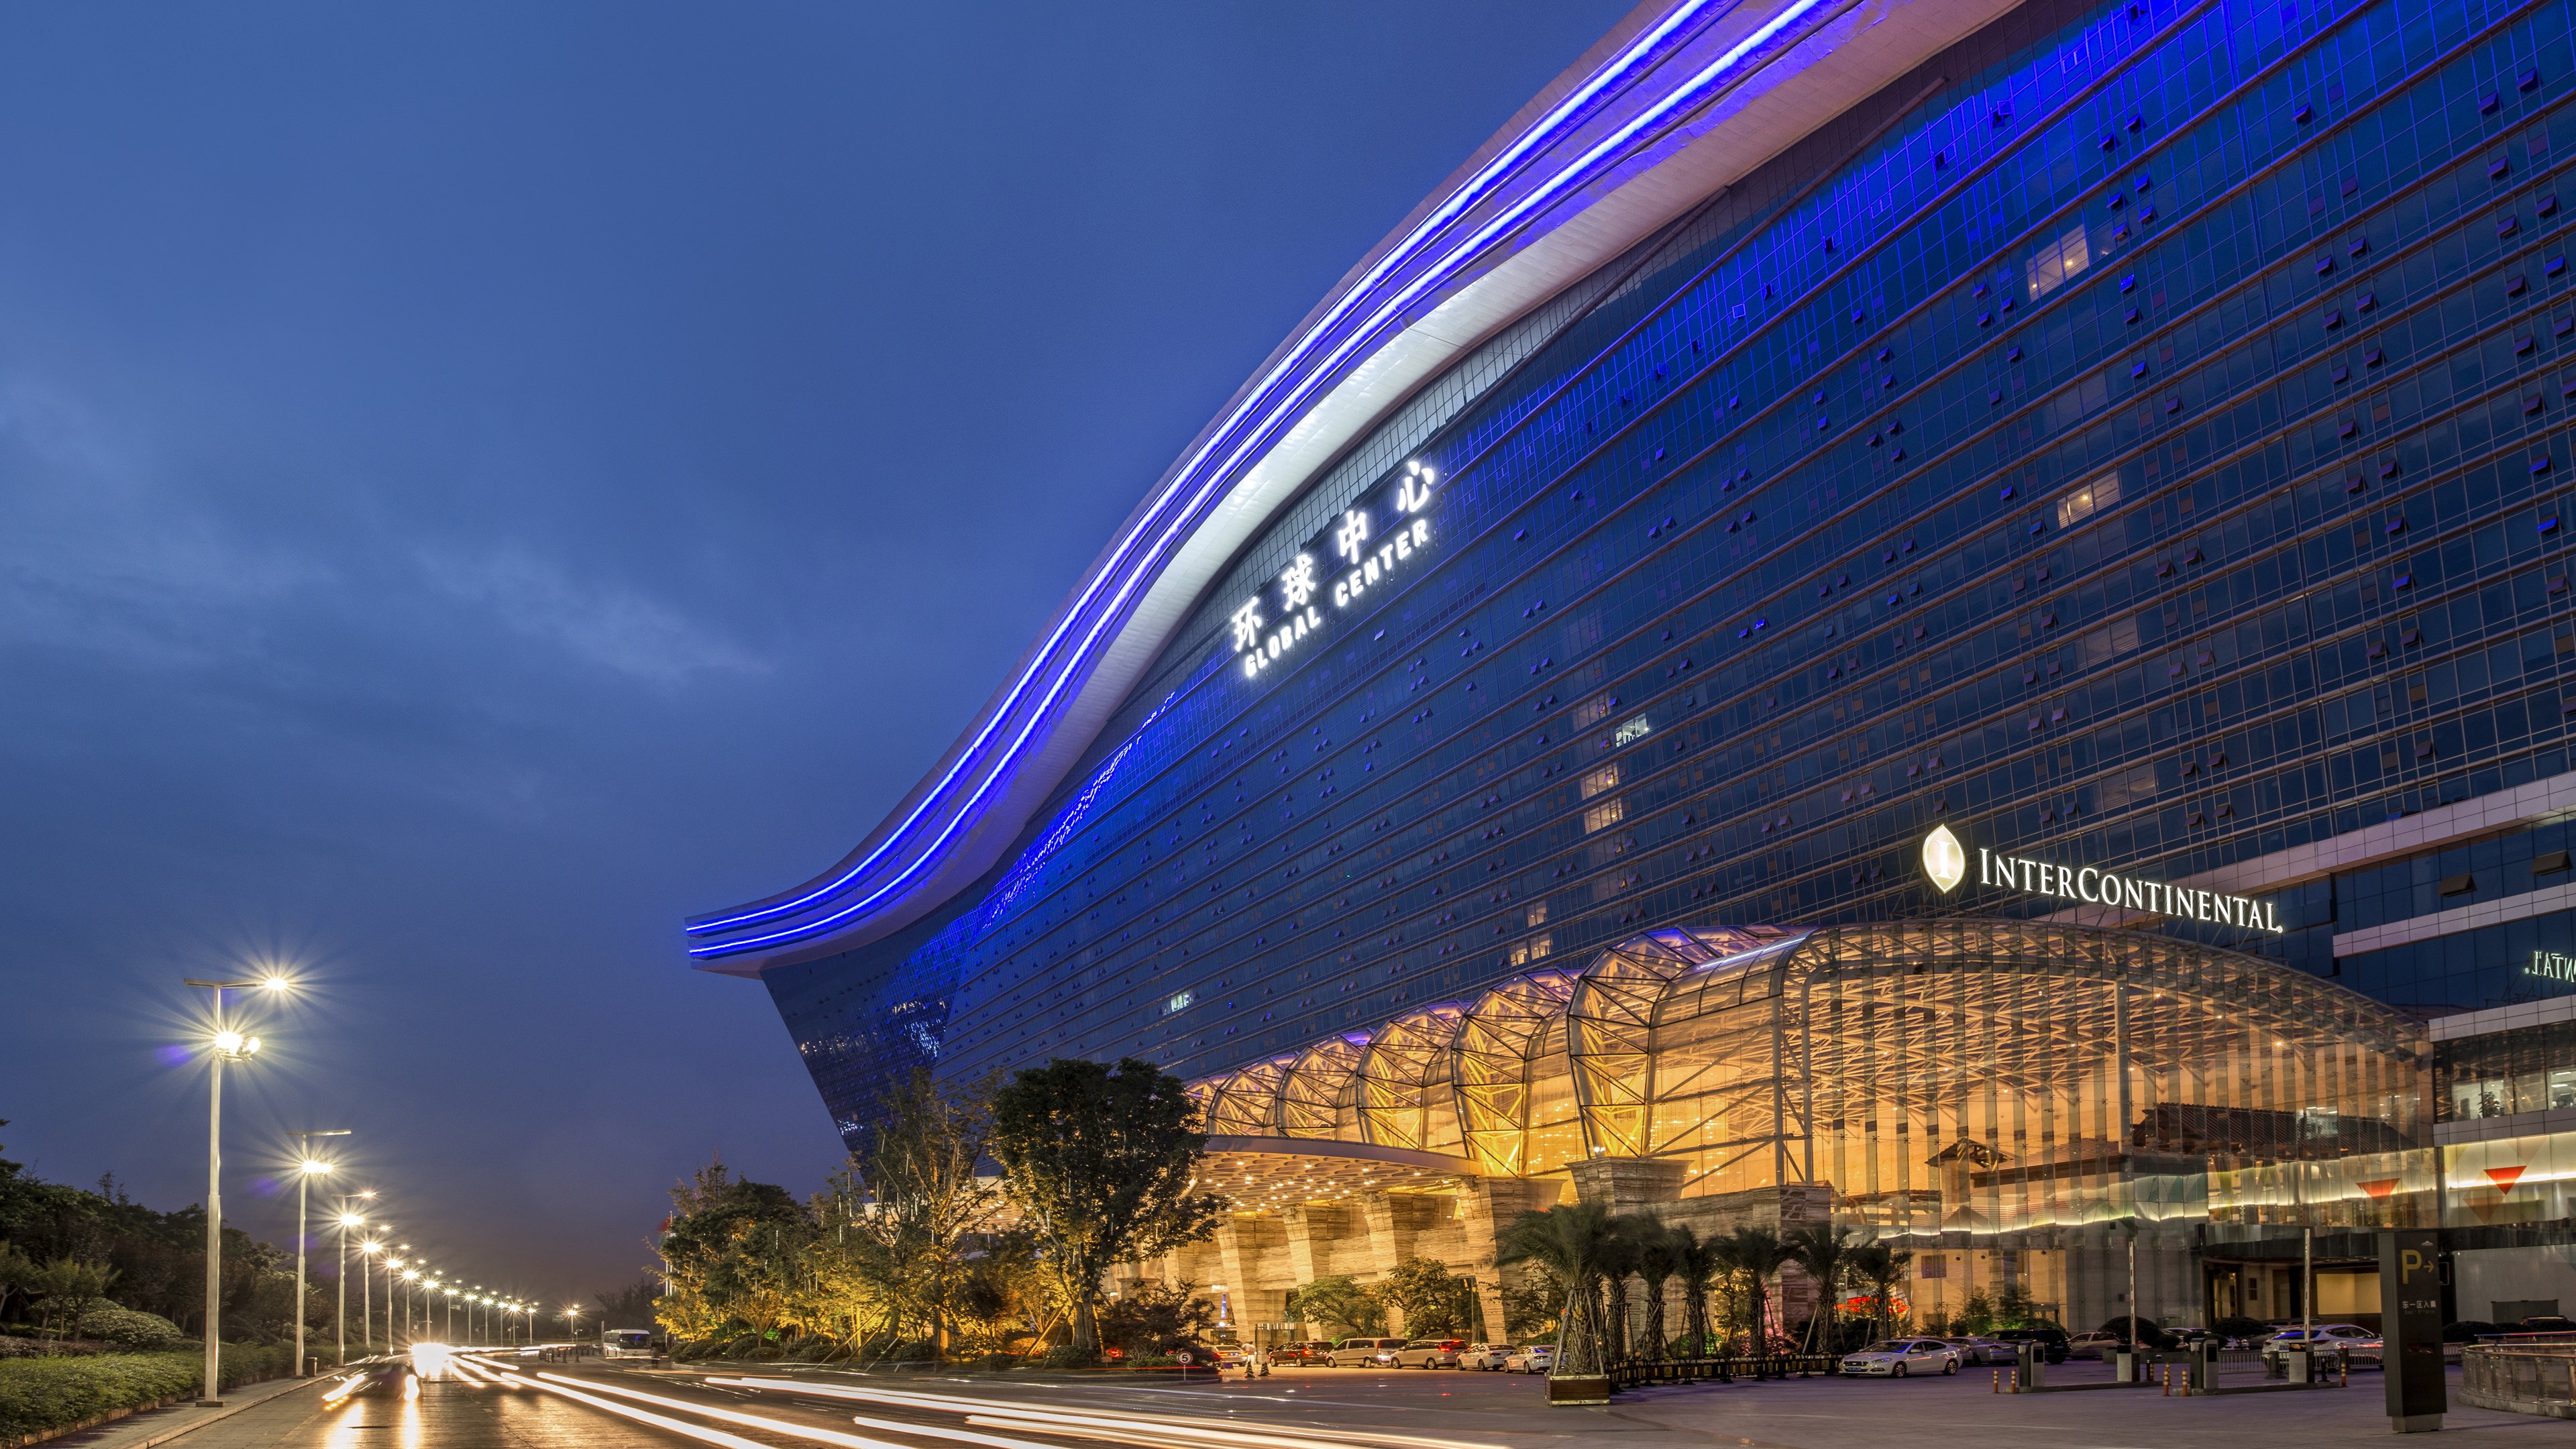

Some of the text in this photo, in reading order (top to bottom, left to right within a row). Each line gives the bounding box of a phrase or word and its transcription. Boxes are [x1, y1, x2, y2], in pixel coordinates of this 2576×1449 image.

[1232, 461, 1434, 652] 环球中心
[1244, 519, 1428, 678] GLOBAL CENTER
[1980, 847, 2278, 932] INTERCONTINENTAL
[2401, 1249, 2422, 1284] P
